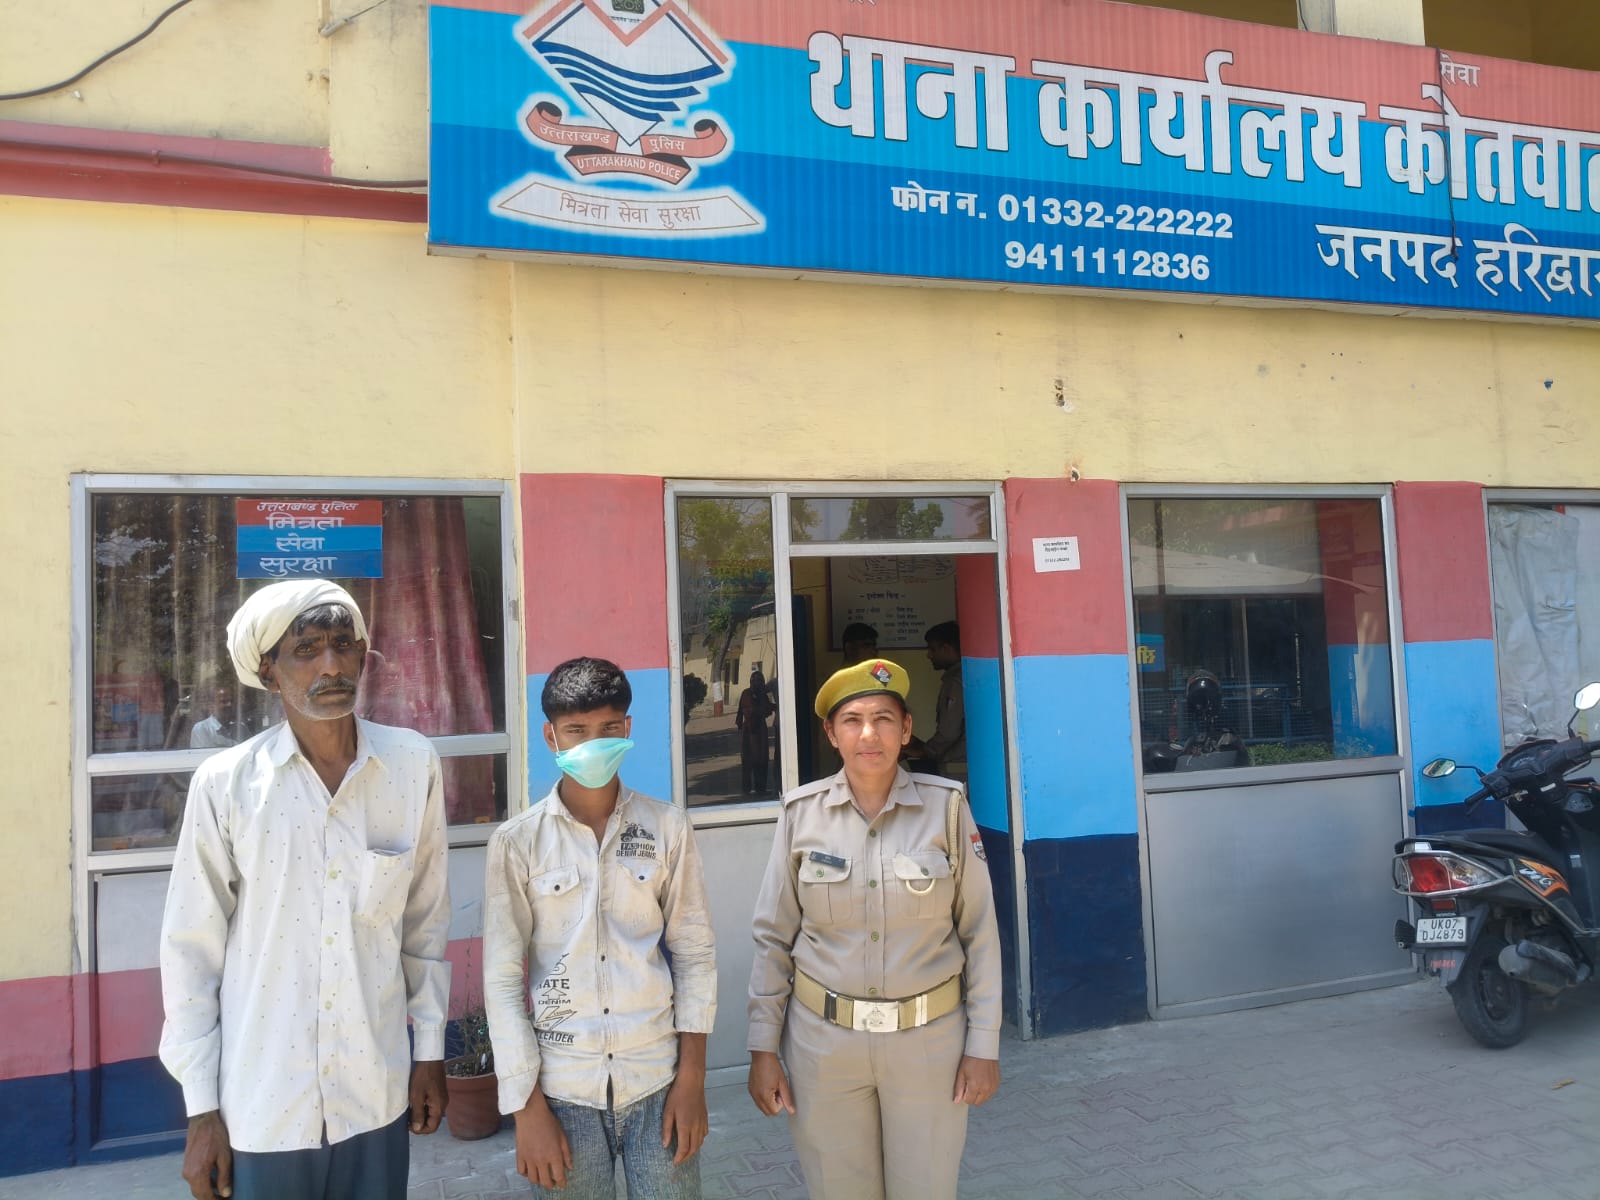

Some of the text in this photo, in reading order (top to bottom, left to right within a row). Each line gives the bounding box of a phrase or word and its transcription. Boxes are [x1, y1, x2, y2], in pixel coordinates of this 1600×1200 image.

[1439, 53, 1481, 87] सेवा
[807, 31, 1016, 152] थाना
[1031, 49, 1367, 188] कार्यालय
[649, 135, 686, 152] पुलिस
[576, 156, 682, 180] UTTARAKHAND POLICE
[560, 193, 702, 229] मित्रता सेवा सुरक्षा
[890, 180, 951, 215] फोन
[998, 194, 1234, 239] 01332-222222
[1004, 240, 1211, 281] 9411112836
[1315, 222, 1600, 302] जनपद हरिद्वा
[266, 511, 345, 531] मित्रता
[276, 532, 326, 552] सेवा
[259, 556, 338, 577] सुरक्षा
[1422, 929, 1464, 941] DJ4879
[1431, 919, 1458, 930] UK07
